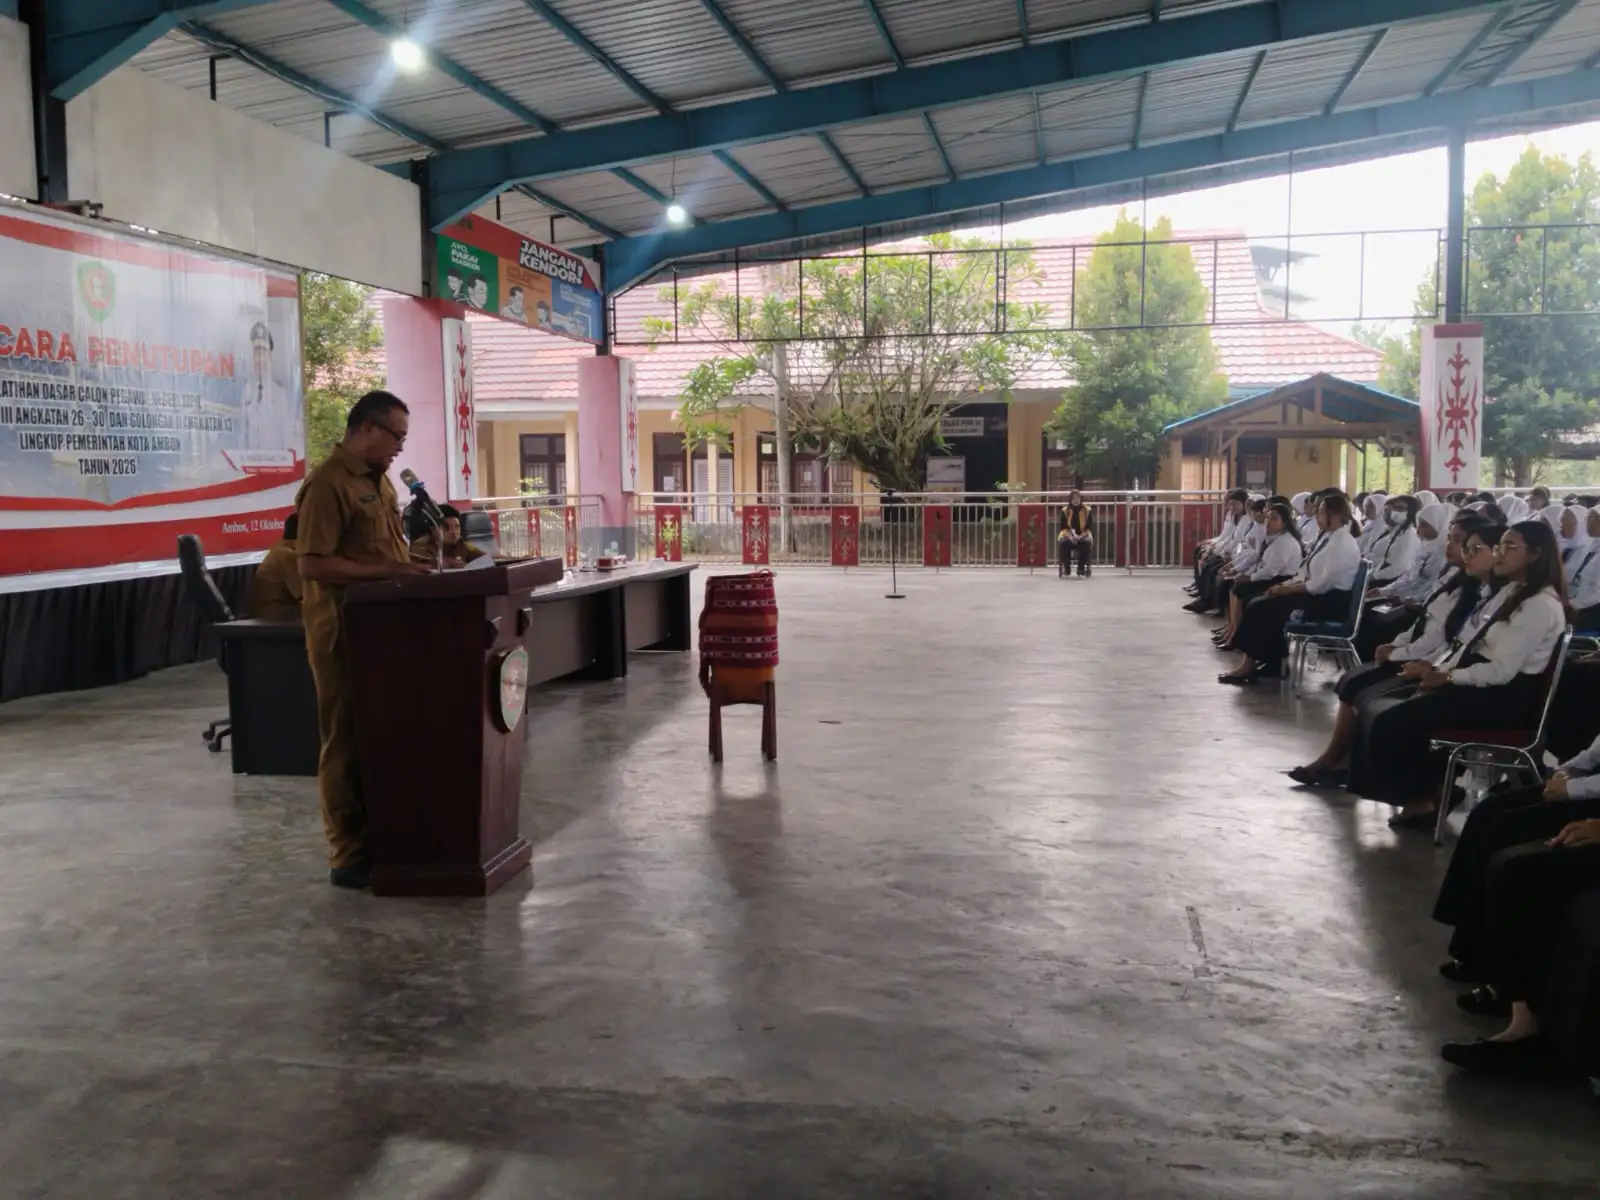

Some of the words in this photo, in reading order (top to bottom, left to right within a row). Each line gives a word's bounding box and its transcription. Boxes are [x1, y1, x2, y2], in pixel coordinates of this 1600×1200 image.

[452, 249, 478, 263] PAKAI
[521, 240, 577, 270] JANGAN
[0, 324, 77, 362] CARA
[88, 336, 235, 378] PENUTUPAN
[42, 383, 75, 400] DASAR
[78, 386, 108, 402] CALON
[1, 406, 12, 424] III
[16, 407, 69, 426] ANGKATAN
[71, 409, 84, 426] 26
[92, 410, 104, 428] 30
[109, 411, 128, 428] DAN
[20, 433, 63, 450] LINGKUP
[66, 435, 125, 451] PEMERINTAH
[128, 436, 149, 451] KOTA
[152, 436, 180, 452] AMBON
[78, 458, 110, 475] TAHUN
